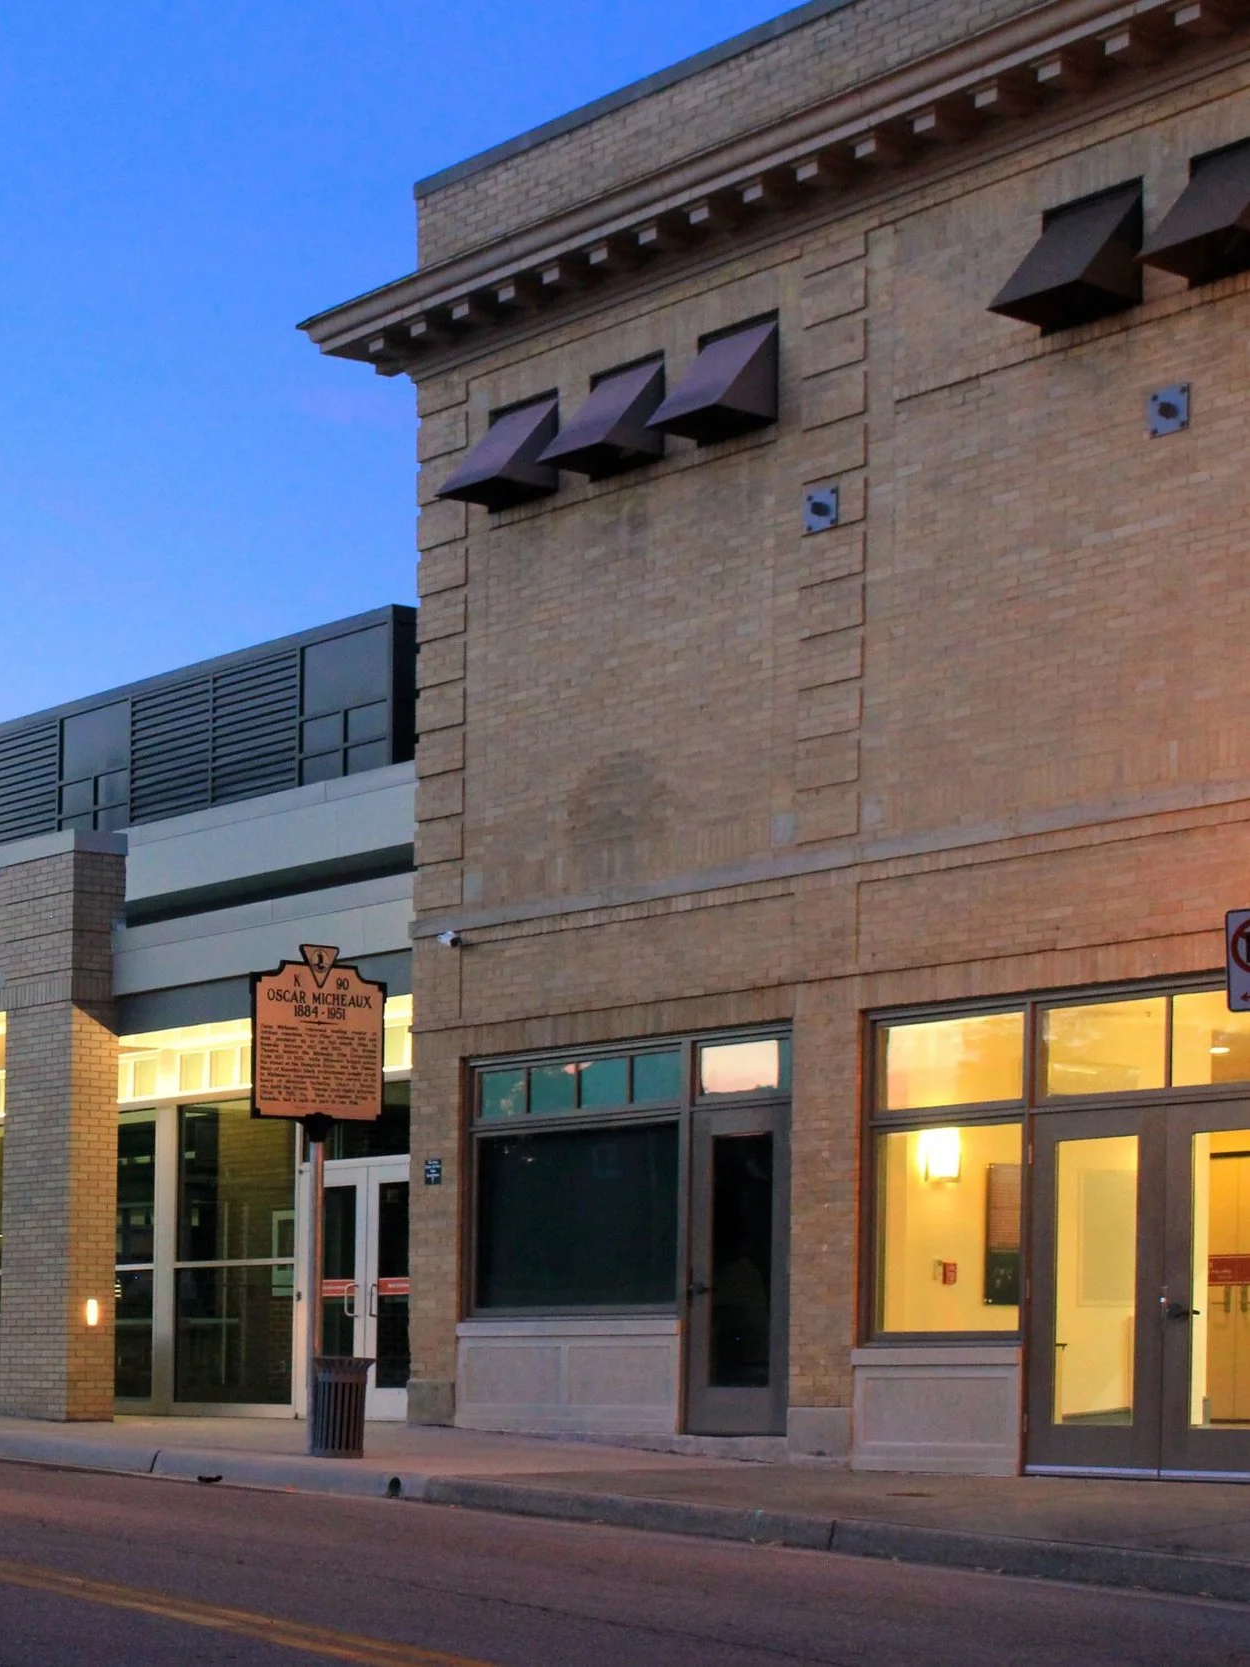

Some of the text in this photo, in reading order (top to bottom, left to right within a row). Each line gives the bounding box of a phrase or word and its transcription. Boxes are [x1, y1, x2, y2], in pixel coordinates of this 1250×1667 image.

[294, 974, 350, 990] K 90
[267, 988, 372, 1009] OSCAR MICHEAUX
